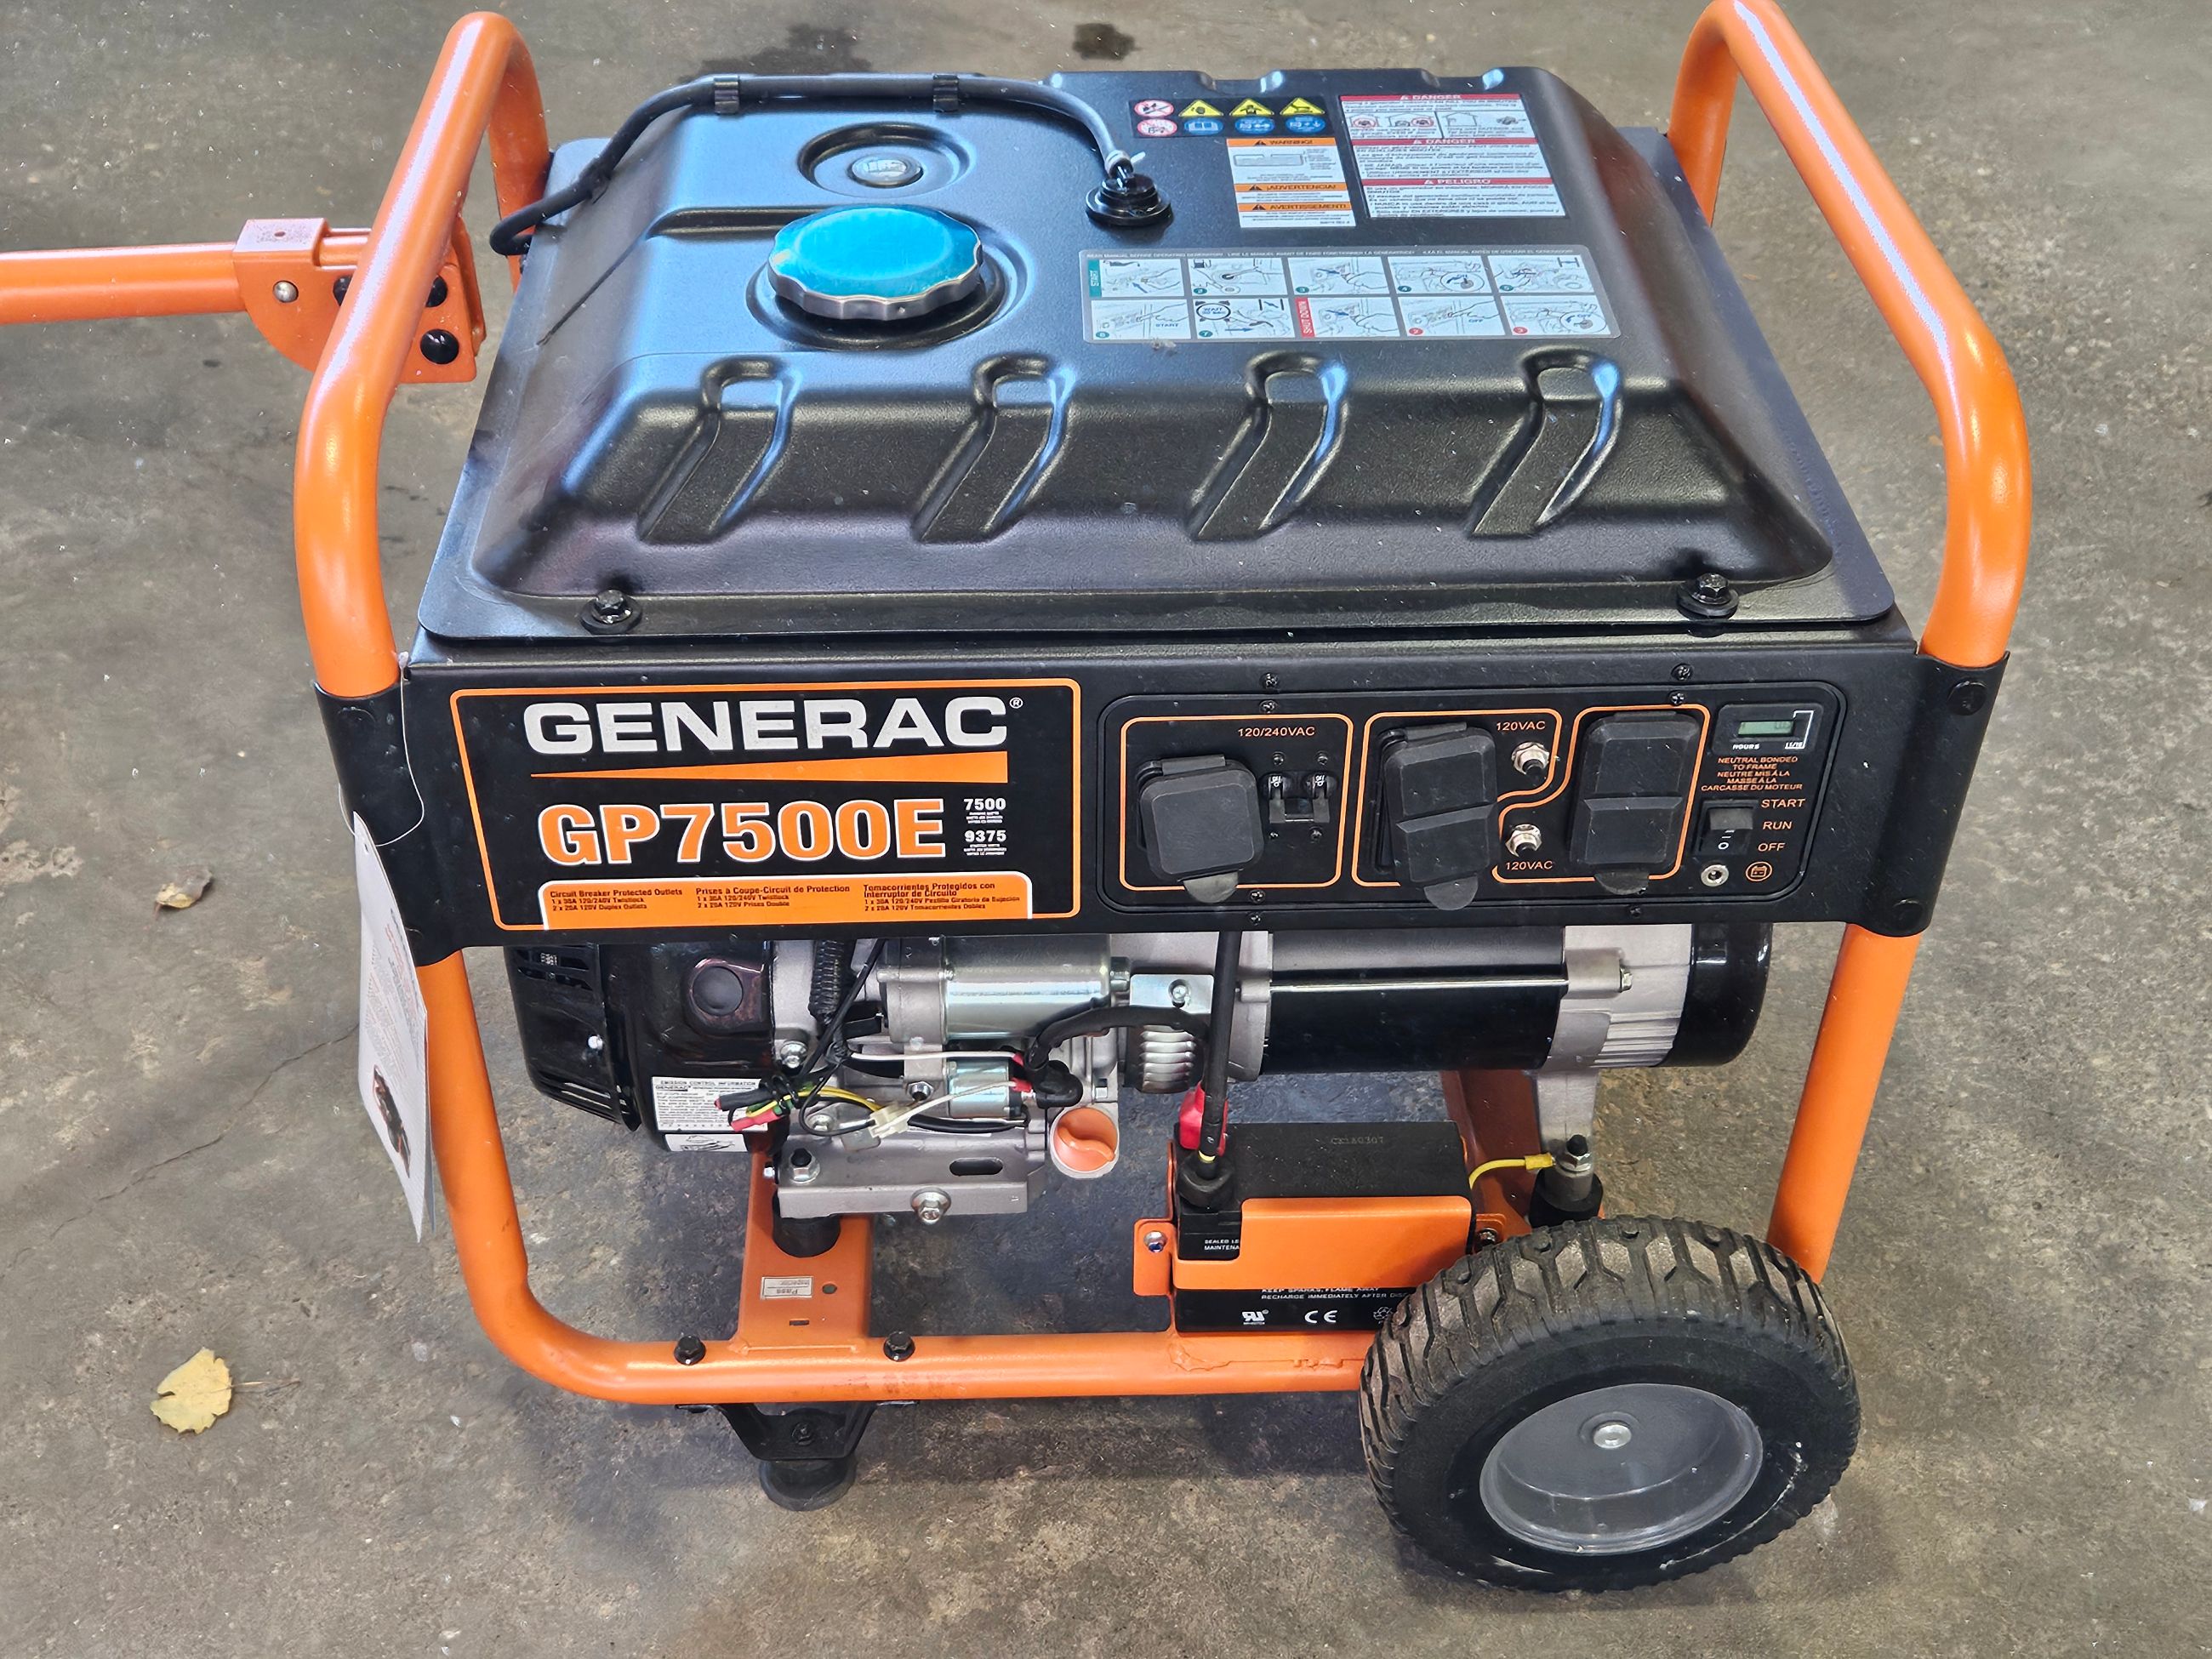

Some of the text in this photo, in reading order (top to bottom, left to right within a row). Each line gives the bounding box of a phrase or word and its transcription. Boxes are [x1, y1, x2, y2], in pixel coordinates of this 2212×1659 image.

[523, 696, 1007, 755] GENERAC
[1497, 721, 1546, 731] 120VAC
[1238, 727, 1315, 737] 120/240VAC
[963, 797, 1006, 811] 7500
[1761, 798, 1806, 808] START
[538, 797, 946, 865] GP7500E
[1763, 821, 1793, 830] RUN
[964, 830, 1006, 842] 9375
[1758, 842, 1786, 852] OFF
[1506, 860, 1553, 871] 120VAC
[1304, 1310, 1338, 1324] CE
